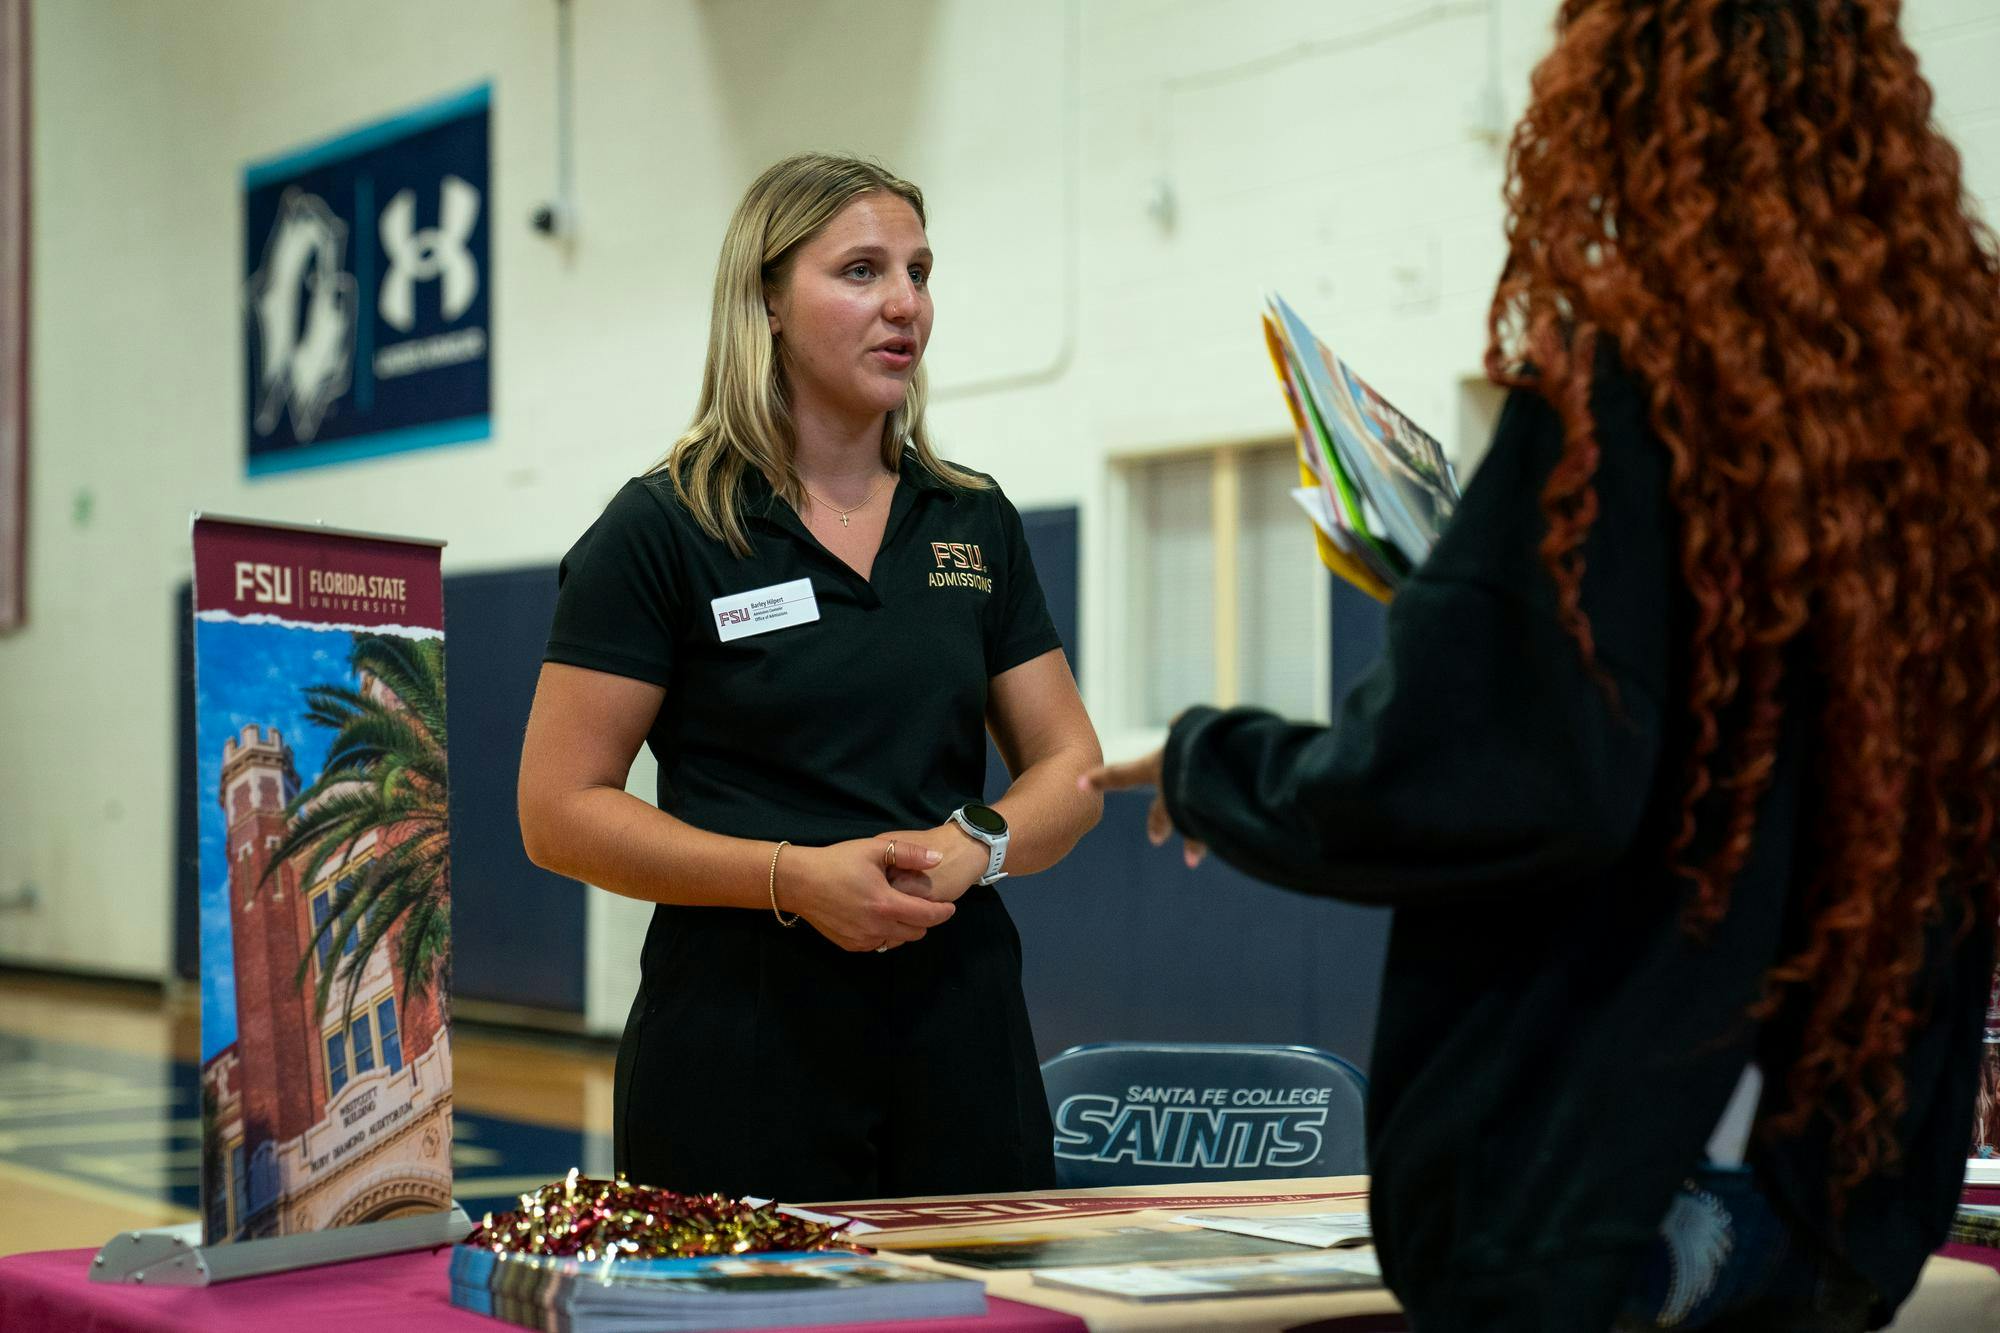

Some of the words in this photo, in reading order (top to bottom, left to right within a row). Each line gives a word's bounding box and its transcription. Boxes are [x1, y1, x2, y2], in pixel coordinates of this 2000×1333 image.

[930, 542, 983, 571] FSU
[235, 562, 292, 604] FSU
[310, 570, 367, 597] FLORIDA
[368, 576, 406, 601] STATE
[928, 572, 992, 594] ADMISSIONS
[310, 598, 407, 615] UNIVERSITY
[719, 607, 751, 626] FSU
[1126, 1085, 1195, 1105] SANTA
[1200, 1087, 1228, 1106] FE
[1231, 1087, 1333, 1106] COLLEGE
[1053, 1094, 1329, 1169] SAINTS
[841, 1201, 1073, 1221] FSU
